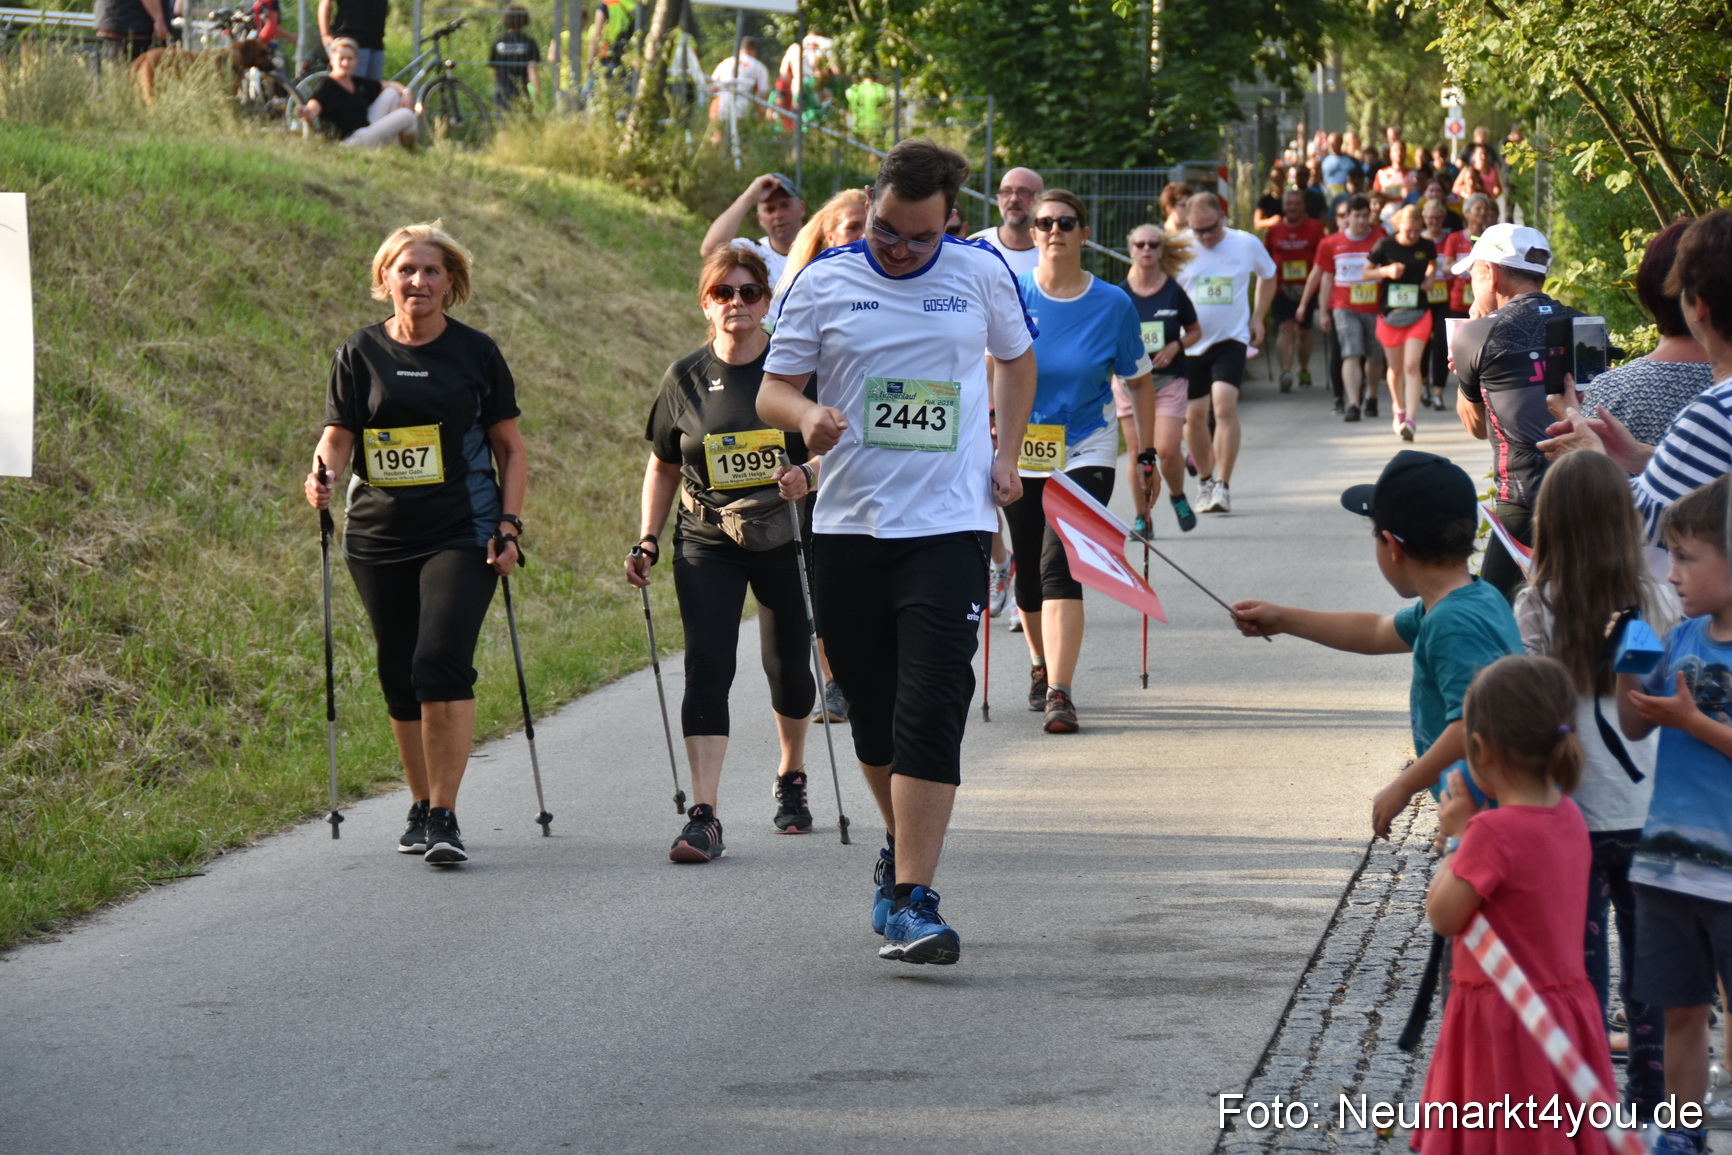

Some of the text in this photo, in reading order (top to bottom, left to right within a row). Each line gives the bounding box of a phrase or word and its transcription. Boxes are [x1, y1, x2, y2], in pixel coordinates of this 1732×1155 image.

[851, 300, 879, 312] JAKO
[923, 295, 968, 313] GOSSNER
[874, 403, 946, 431] 2443
[374, 447, 429, 470] 1967
[1020, 440, 1057, 459] 065
[717, 450, 776, 473] 1999
